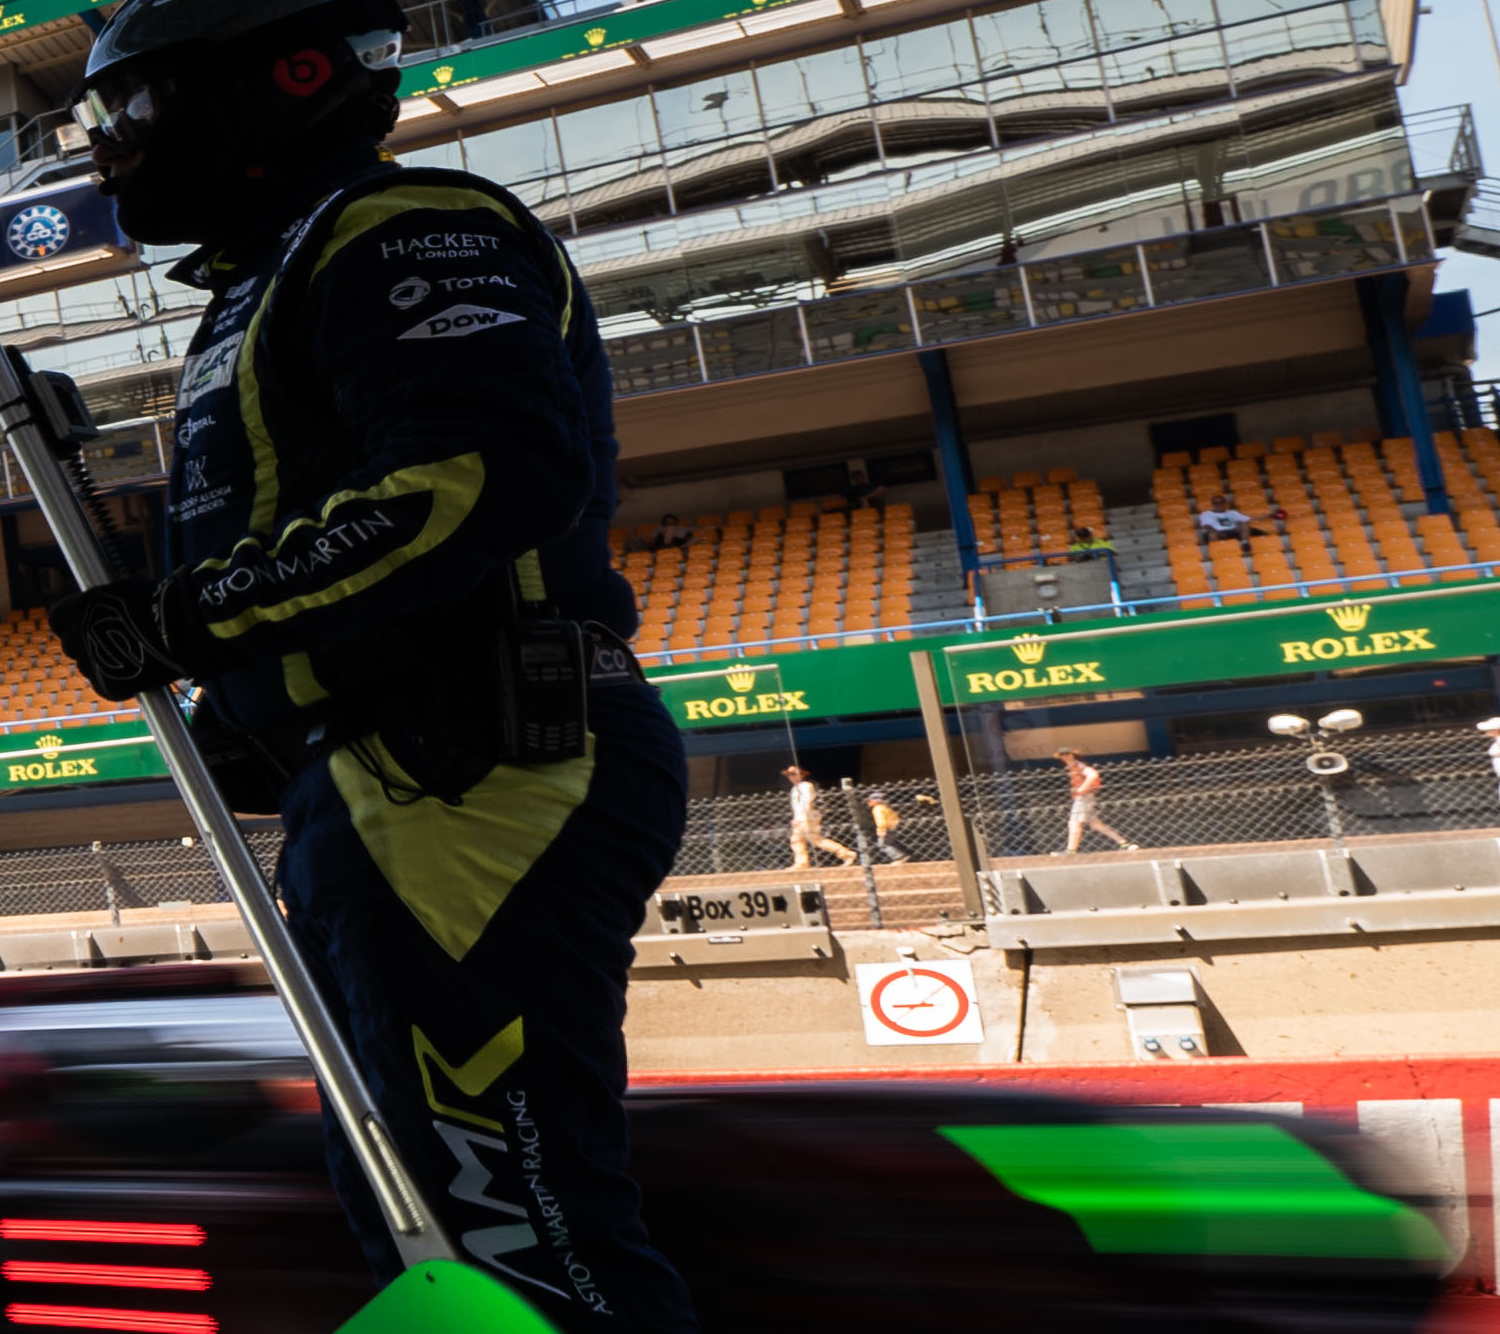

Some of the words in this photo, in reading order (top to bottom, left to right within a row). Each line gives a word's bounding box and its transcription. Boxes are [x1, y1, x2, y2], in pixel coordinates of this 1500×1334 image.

[380, 232, 501, 260] HACKETT
[415, 248, 481, 260] LONDON
[437, 275, 518, 292] TOTAL
[426, 312, 500, 336] DOW
[275, 508, 396, 581] MARTIN
[1280, 628, 1436, 663] ROLEX
[966, 662, 1106, 694] ROLEX
[684, 690, 810, 720] ROLEX
[8, 758, 98, 782] ROLEX
[686, 894, 734, 921] Box
[737, 890, 770, 919] 39
[505, 1089, 542, 1171] RACING
